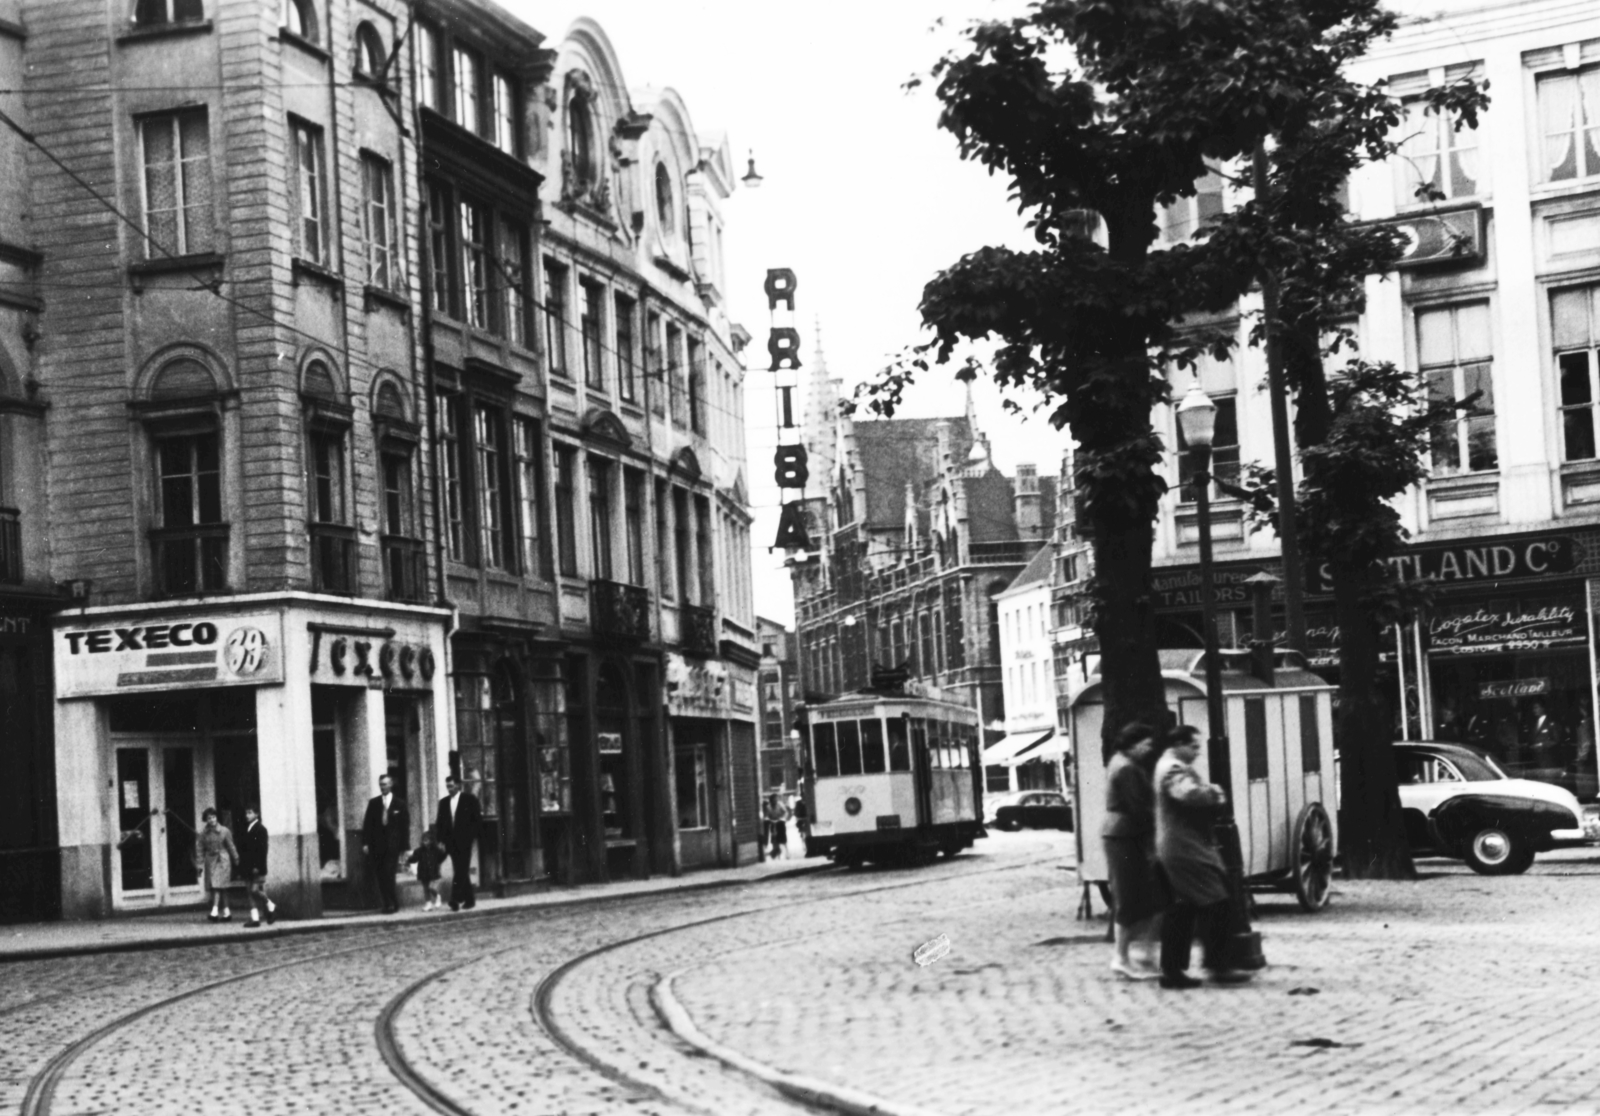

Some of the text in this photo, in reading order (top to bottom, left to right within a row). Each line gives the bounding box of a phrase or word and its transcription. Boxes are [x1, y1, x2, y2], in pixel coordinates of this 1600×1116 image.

[1319, 546, 1515, 592] STLAND
[0, 616, 30, 634] NT
[64, 622, 218, 655] TEXECO
